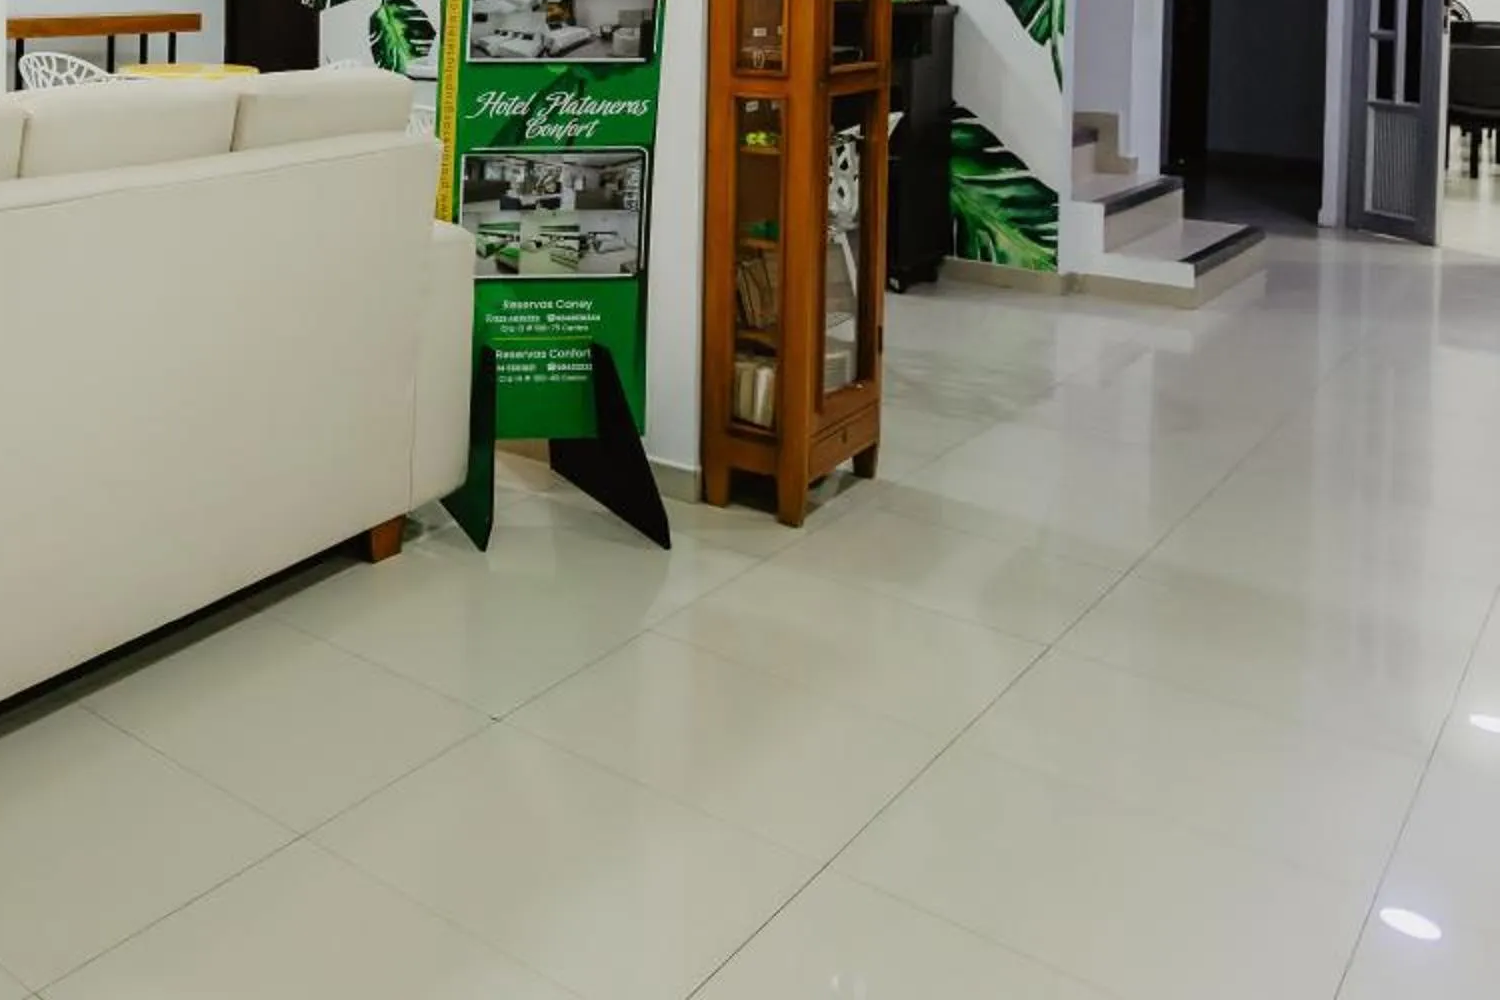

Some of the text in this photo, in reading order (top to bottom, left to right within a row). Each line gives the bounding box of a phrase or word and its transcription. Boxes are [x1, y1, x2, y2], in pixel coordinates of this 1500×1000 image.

[465, 91, 651, 119] Hotel Plataneras
[525, 116, 600, 143] Confort
